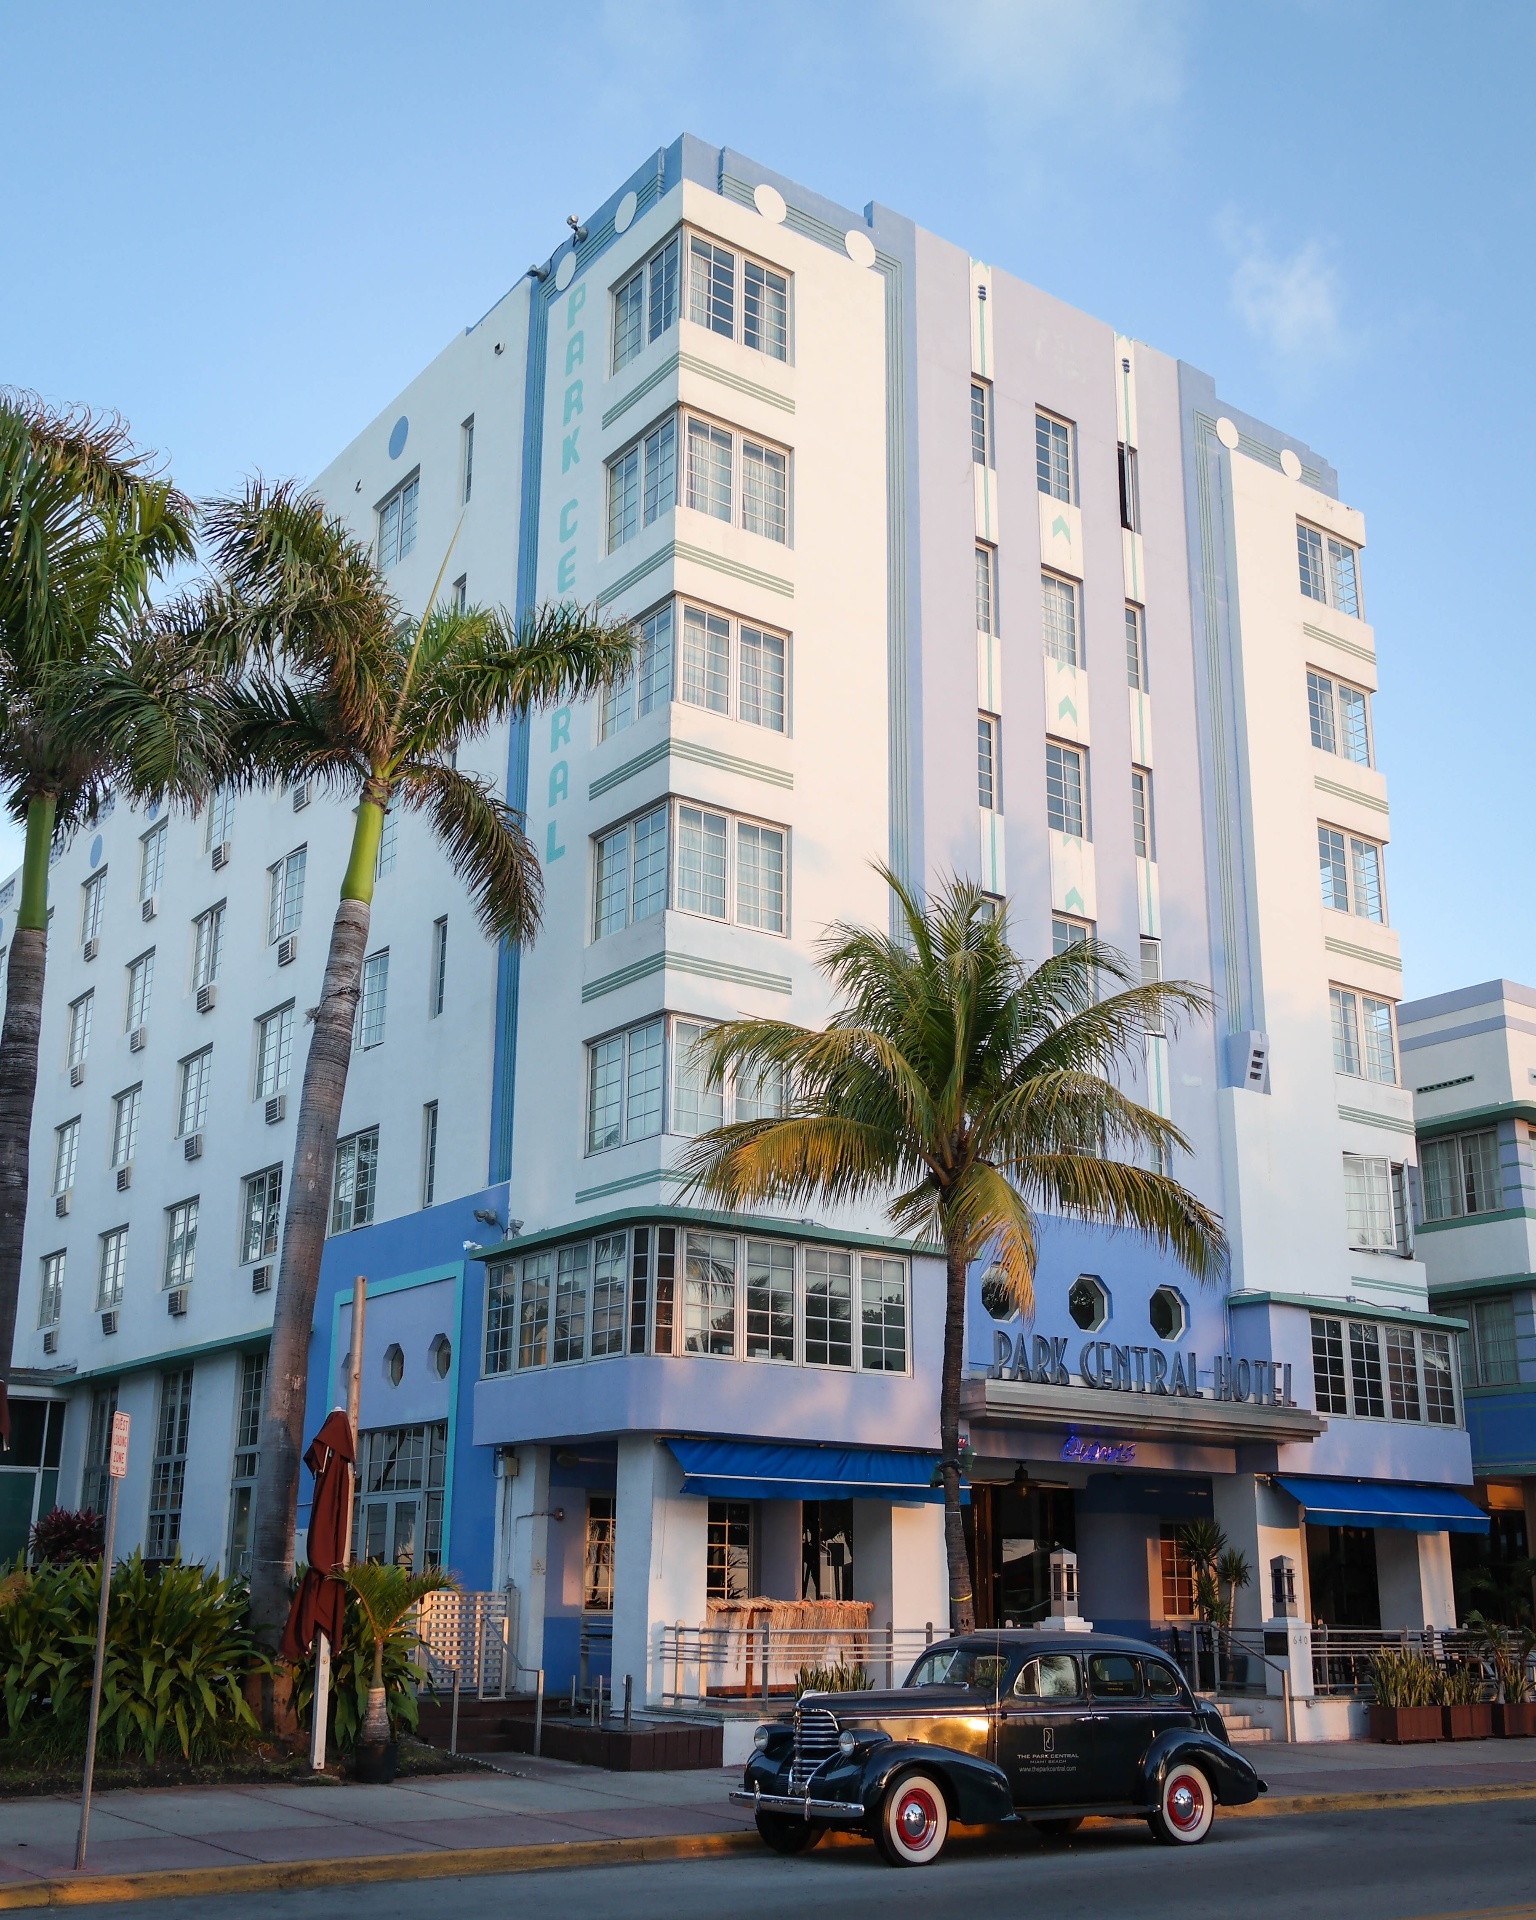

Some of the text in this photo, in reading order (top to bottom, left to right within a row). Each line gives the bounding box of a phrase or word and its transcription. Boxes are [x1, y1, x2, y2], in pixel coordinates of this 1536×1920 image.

[562, 282, 586, 476] PARK
[992, 1330, 1298, 1407] PARK CENTRAL HOTEL
[114, 1417, 129, 1431] GUEST
[113, 1450, 125, 1464] ZONE
[1293, 1635, 1308, 1645] 640
